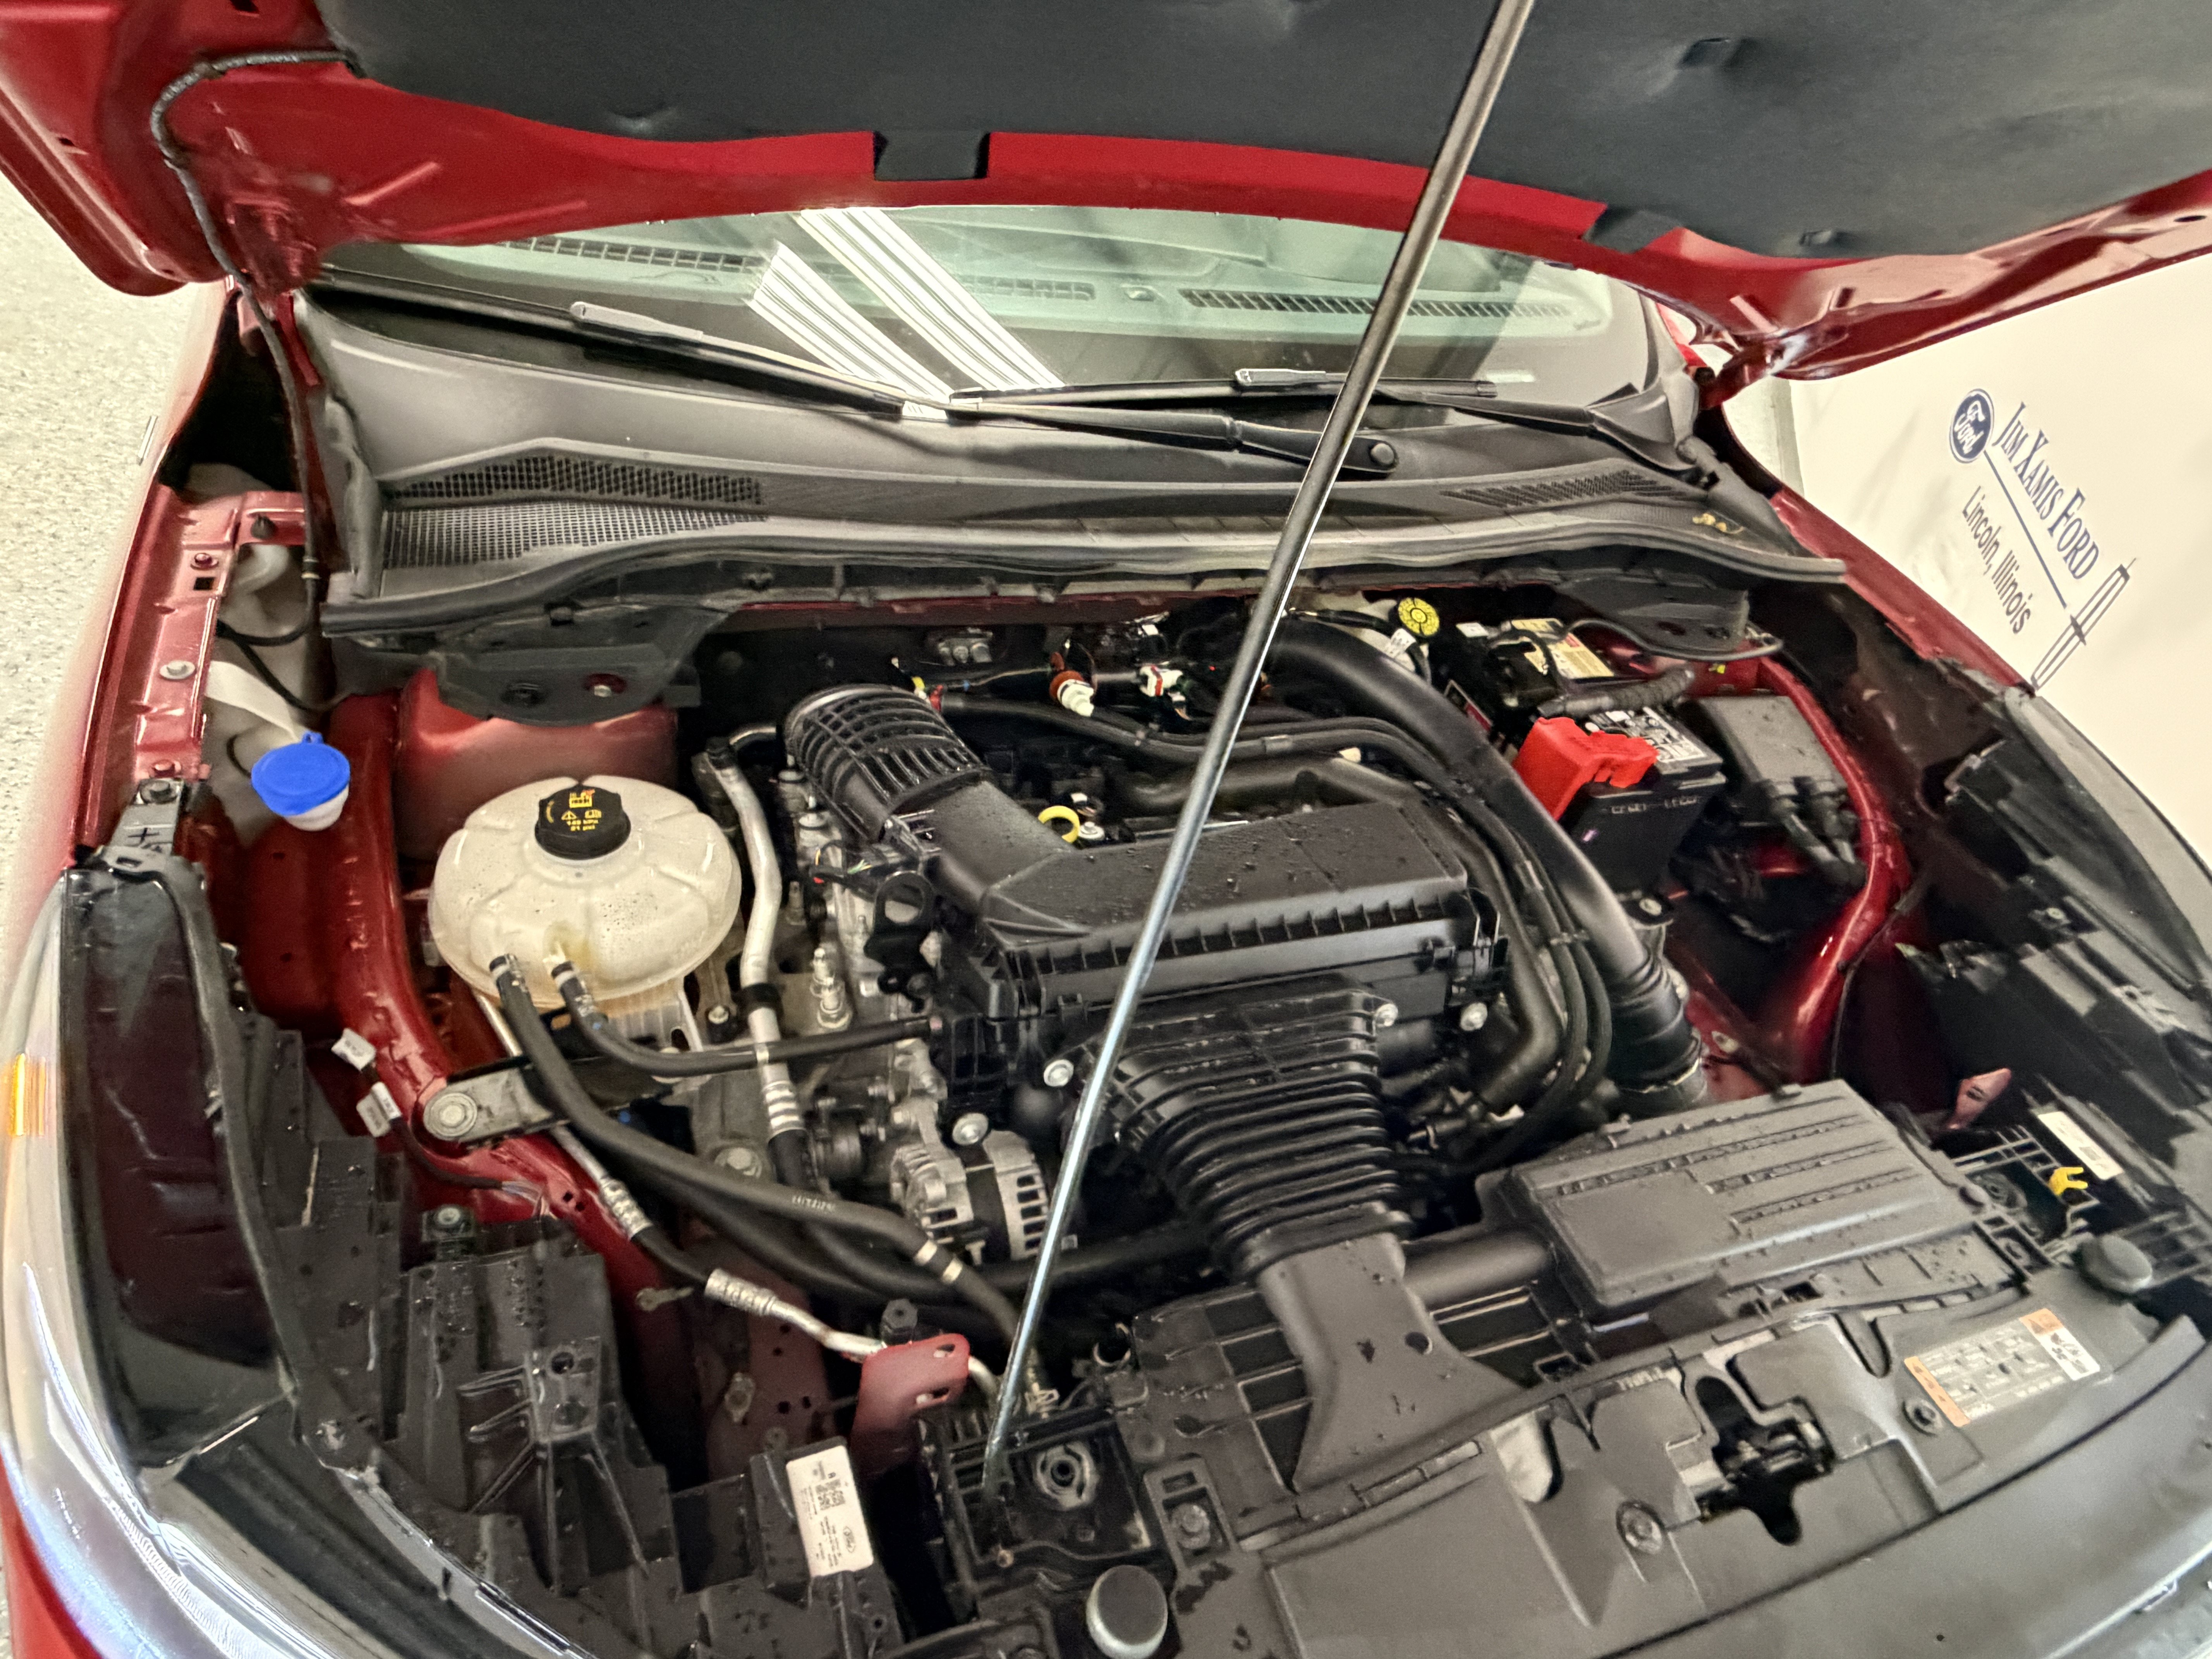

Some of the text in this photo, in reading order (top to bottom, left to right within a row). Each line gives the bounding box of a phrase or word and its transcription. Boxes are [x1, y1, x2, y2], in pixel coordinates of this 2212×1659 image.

[1953, 400, 1985, 455] Ford
[1962, 486, 2033, 635] Lincoln, Illinois
